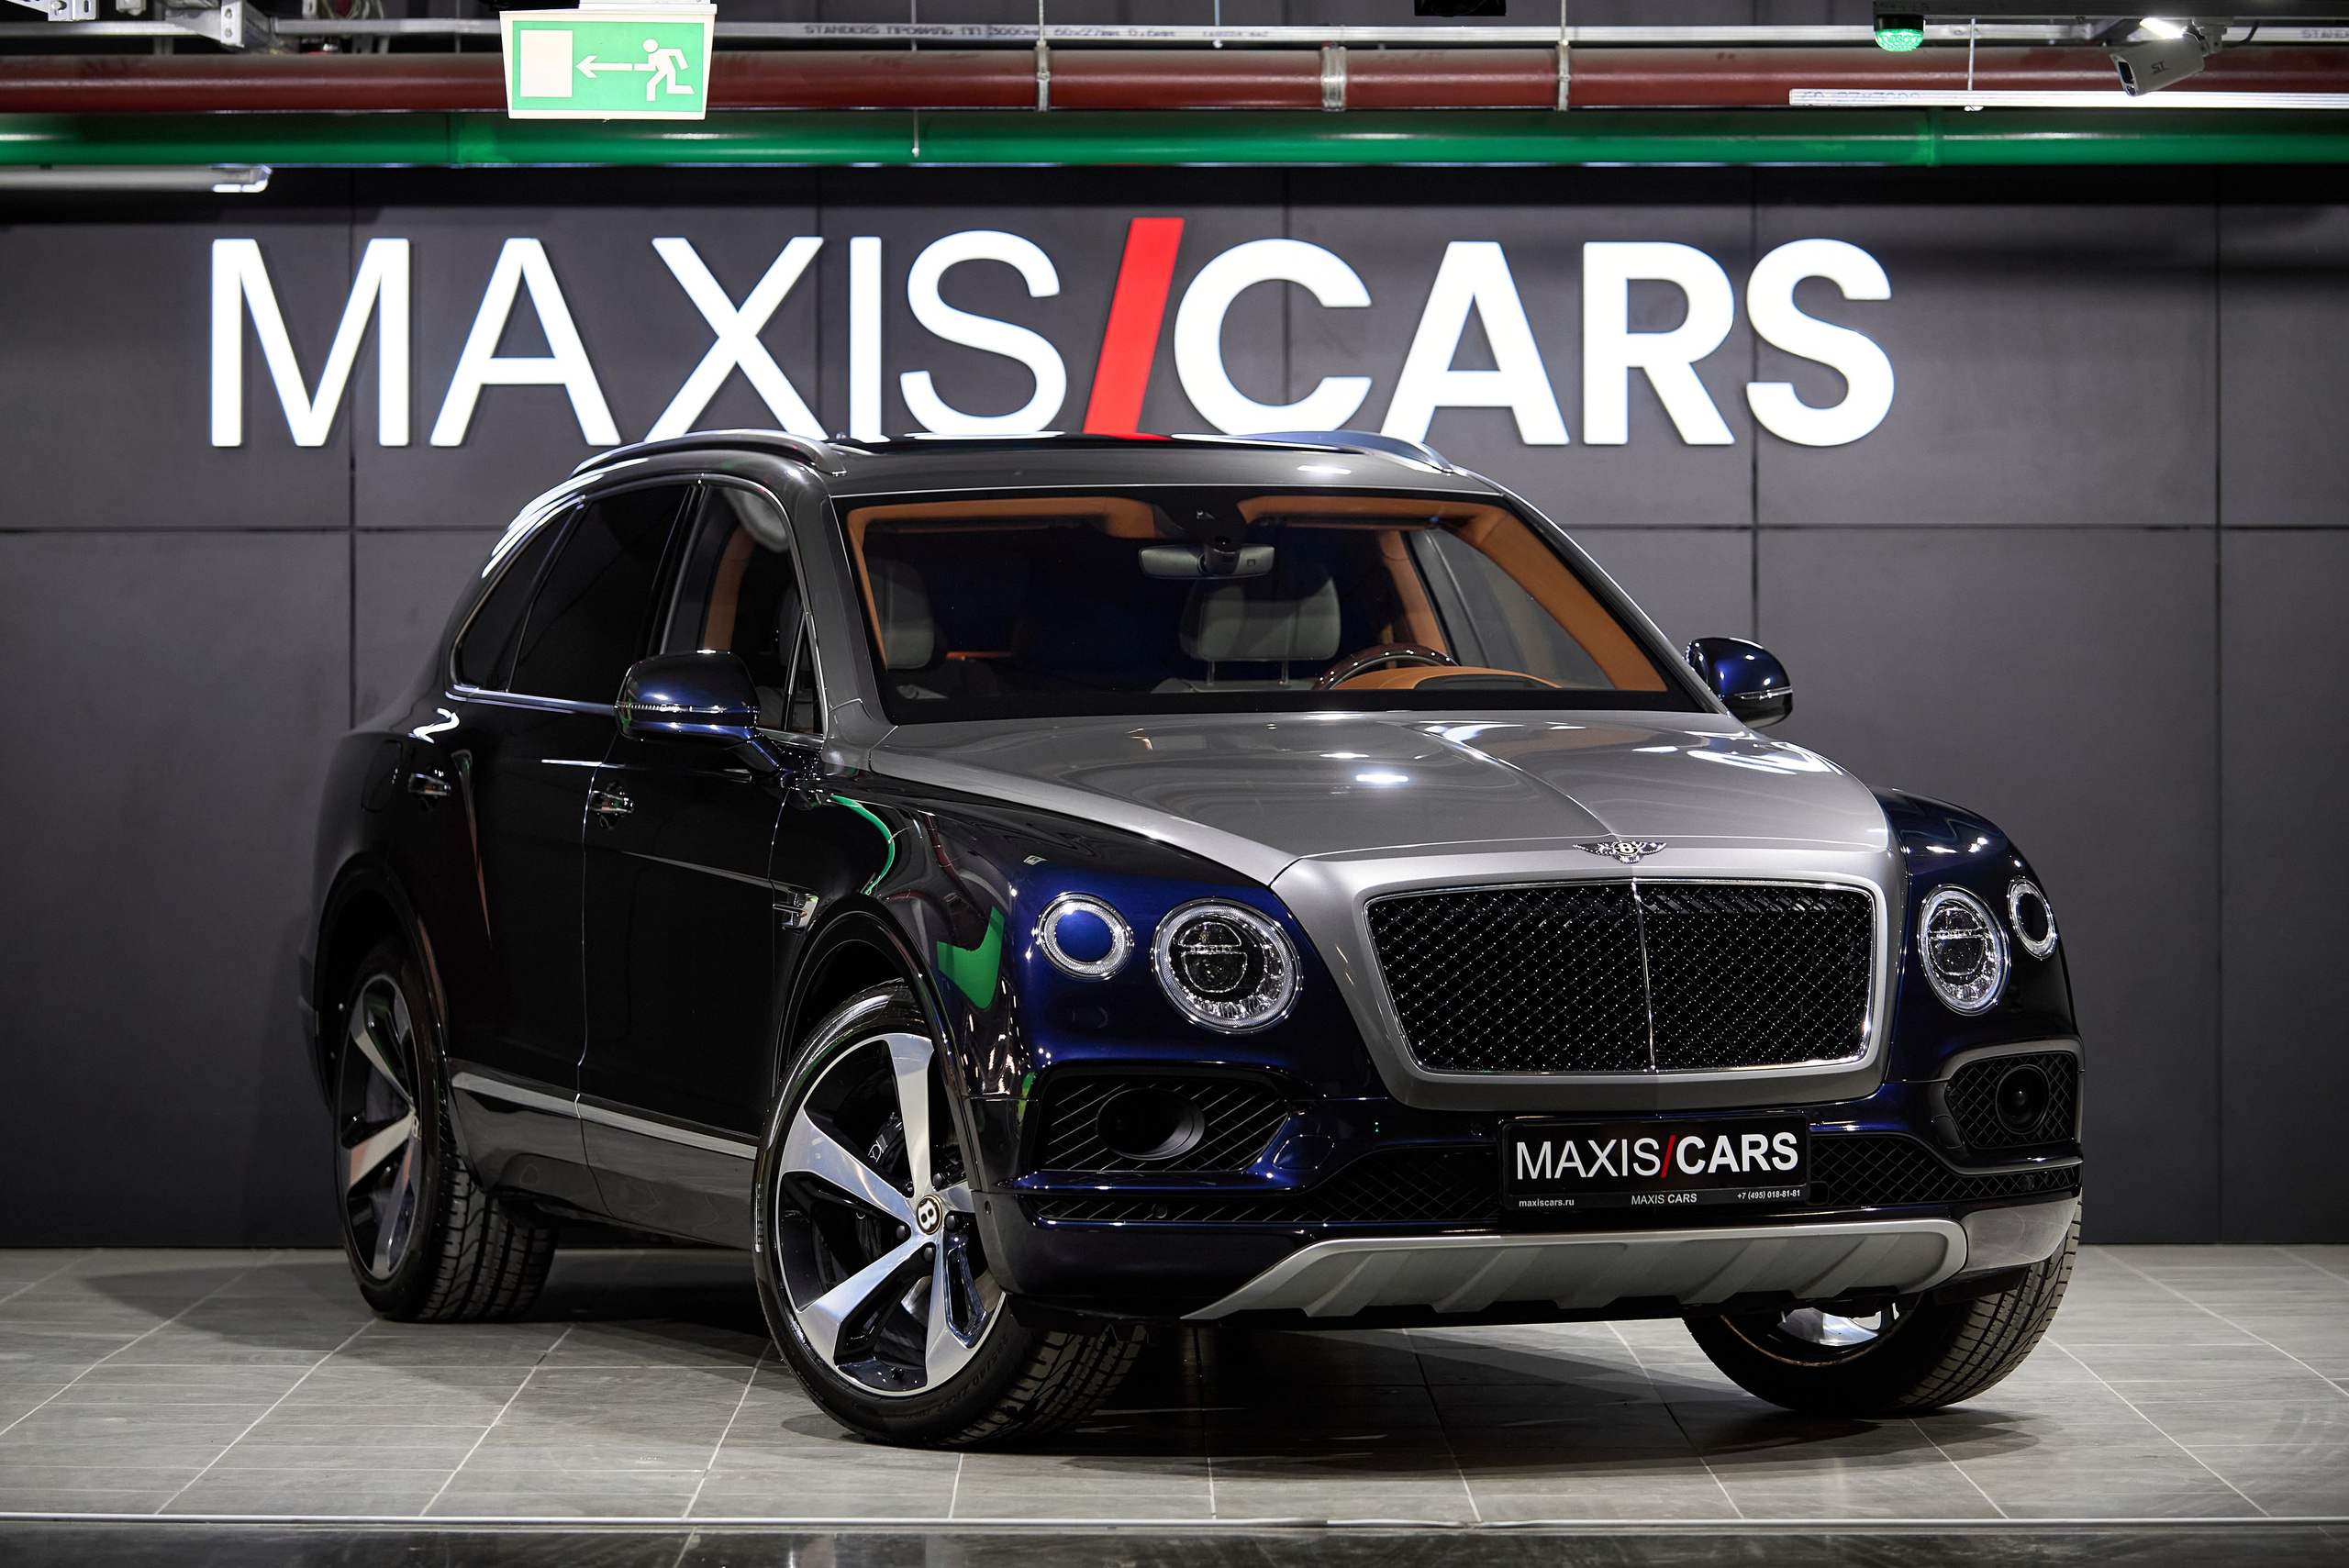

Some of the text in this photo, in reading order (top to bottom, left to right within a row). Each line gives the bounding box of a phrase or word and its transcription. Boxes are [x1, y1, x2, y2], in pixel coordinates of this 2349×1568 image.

[1516, 1131, 1798, 1181] MAXIS/CARS
[1631, 1193, 1698, 1206] MAXIS/CARS
[1737, 1189, 1801, 1200] +7 (495) 018-81-81
[1519, 1198, 1575, 1207] maxiscars.ru
[918, 1199, 938, 1230] B
